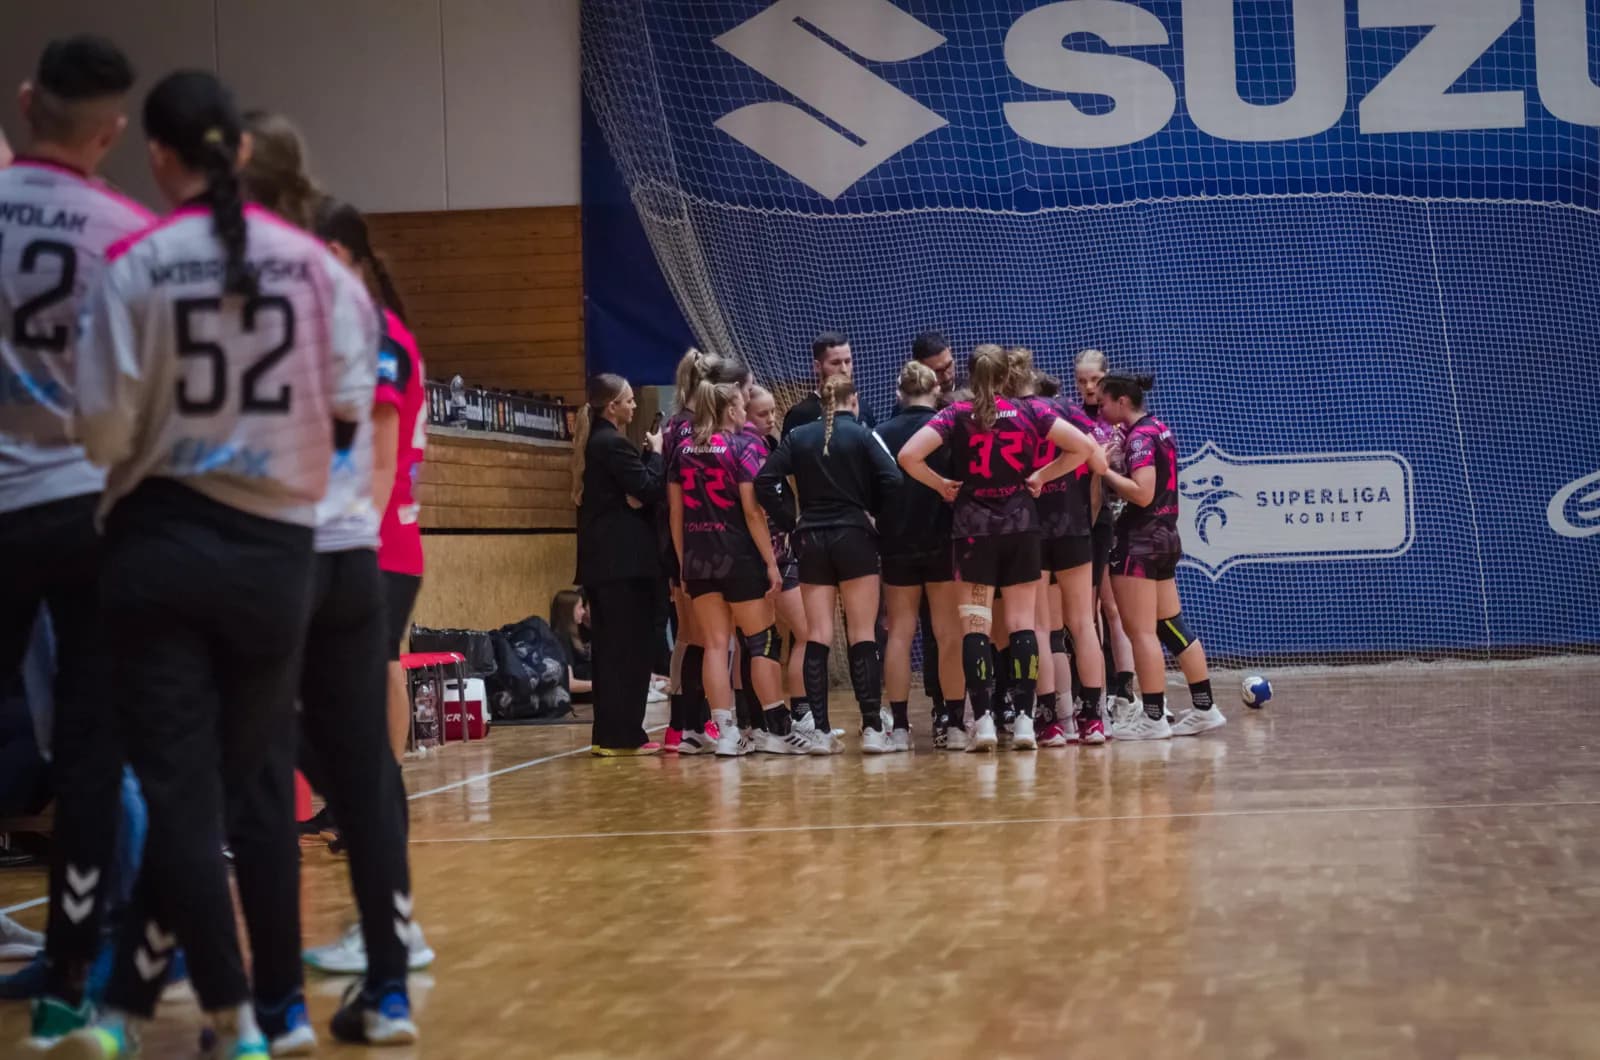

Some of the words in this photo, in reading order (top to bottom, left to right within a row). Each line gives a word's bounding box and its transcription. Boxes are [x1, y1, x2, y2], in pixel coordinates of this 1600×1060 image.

[0, 238, 77, 352] 2
[174, 296, 296, 415] 52
[1256, 487, 1391, 507] SUPERLIGA
[1285, 511, 1363, 524] KOBIET
